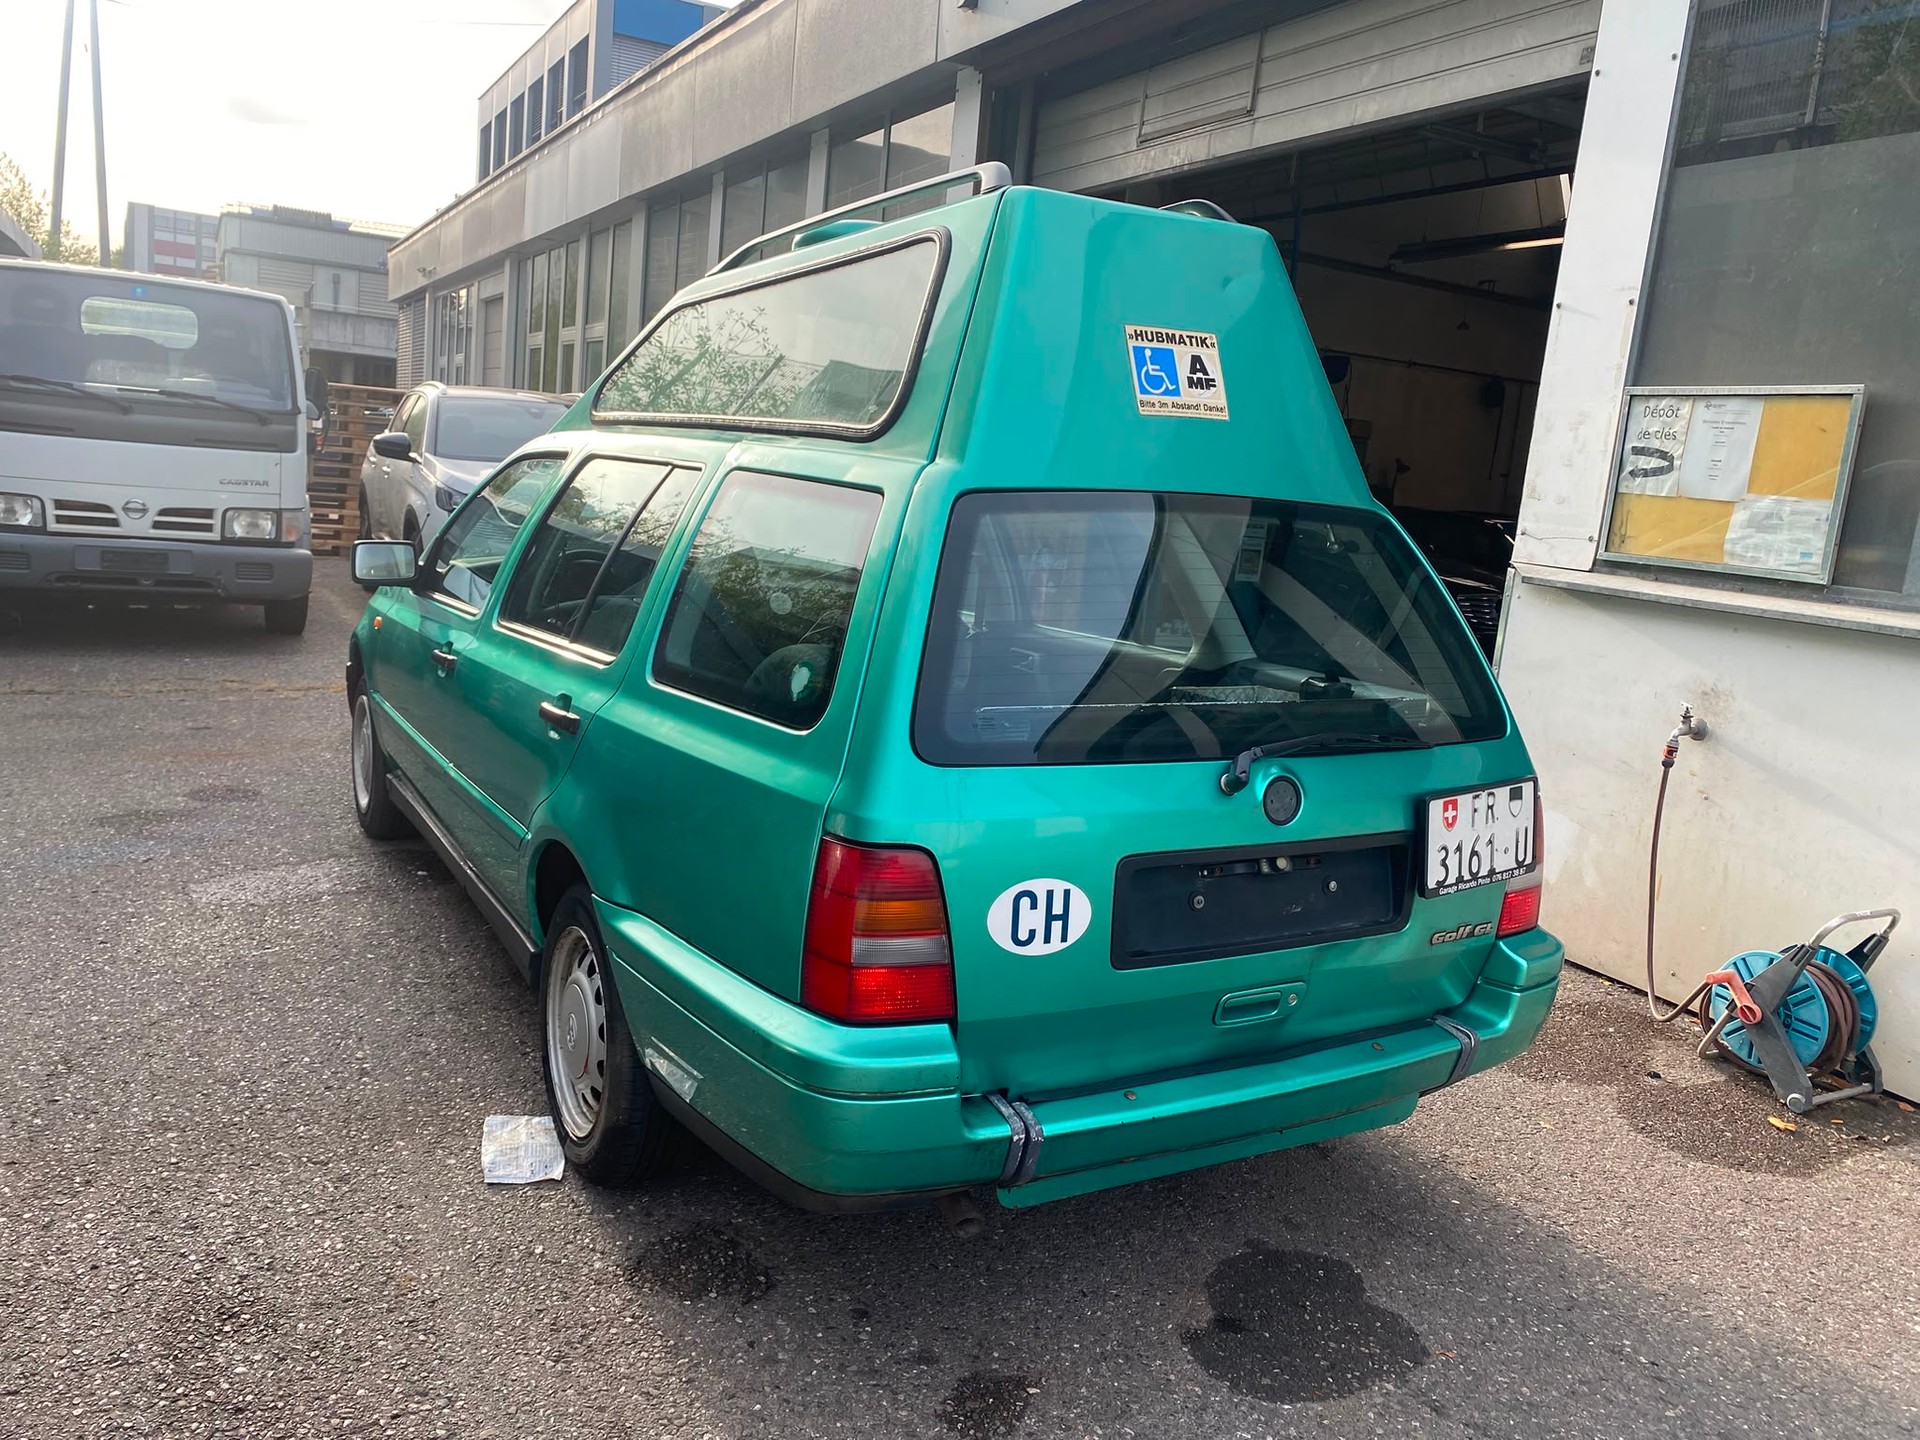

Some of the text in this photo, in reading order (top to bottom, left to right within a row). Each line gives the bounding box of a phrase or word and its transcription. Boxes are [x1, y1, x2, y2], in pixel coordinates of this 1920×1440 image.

[1189, 354, 1210, 376] A
[1187, 376, 1217, 390] MF
[1140, 400, 1156, 409] Bitte
[1158, 401, 1169, 409] 3m
[1171, 402, 1202, 411] Abstand!
[1203, 404, 1227, 414] Danke!
[1643, 404, 1681, 419] Dépôt
[1654, 427, 1677, 440] clés
[1439, 885, 1458, 895] Garage
[1458, 880, 1477, 890] Ricardo
[1011, 889, 1071, 947] CH
[1431, 923, 1472, 945] Golf
